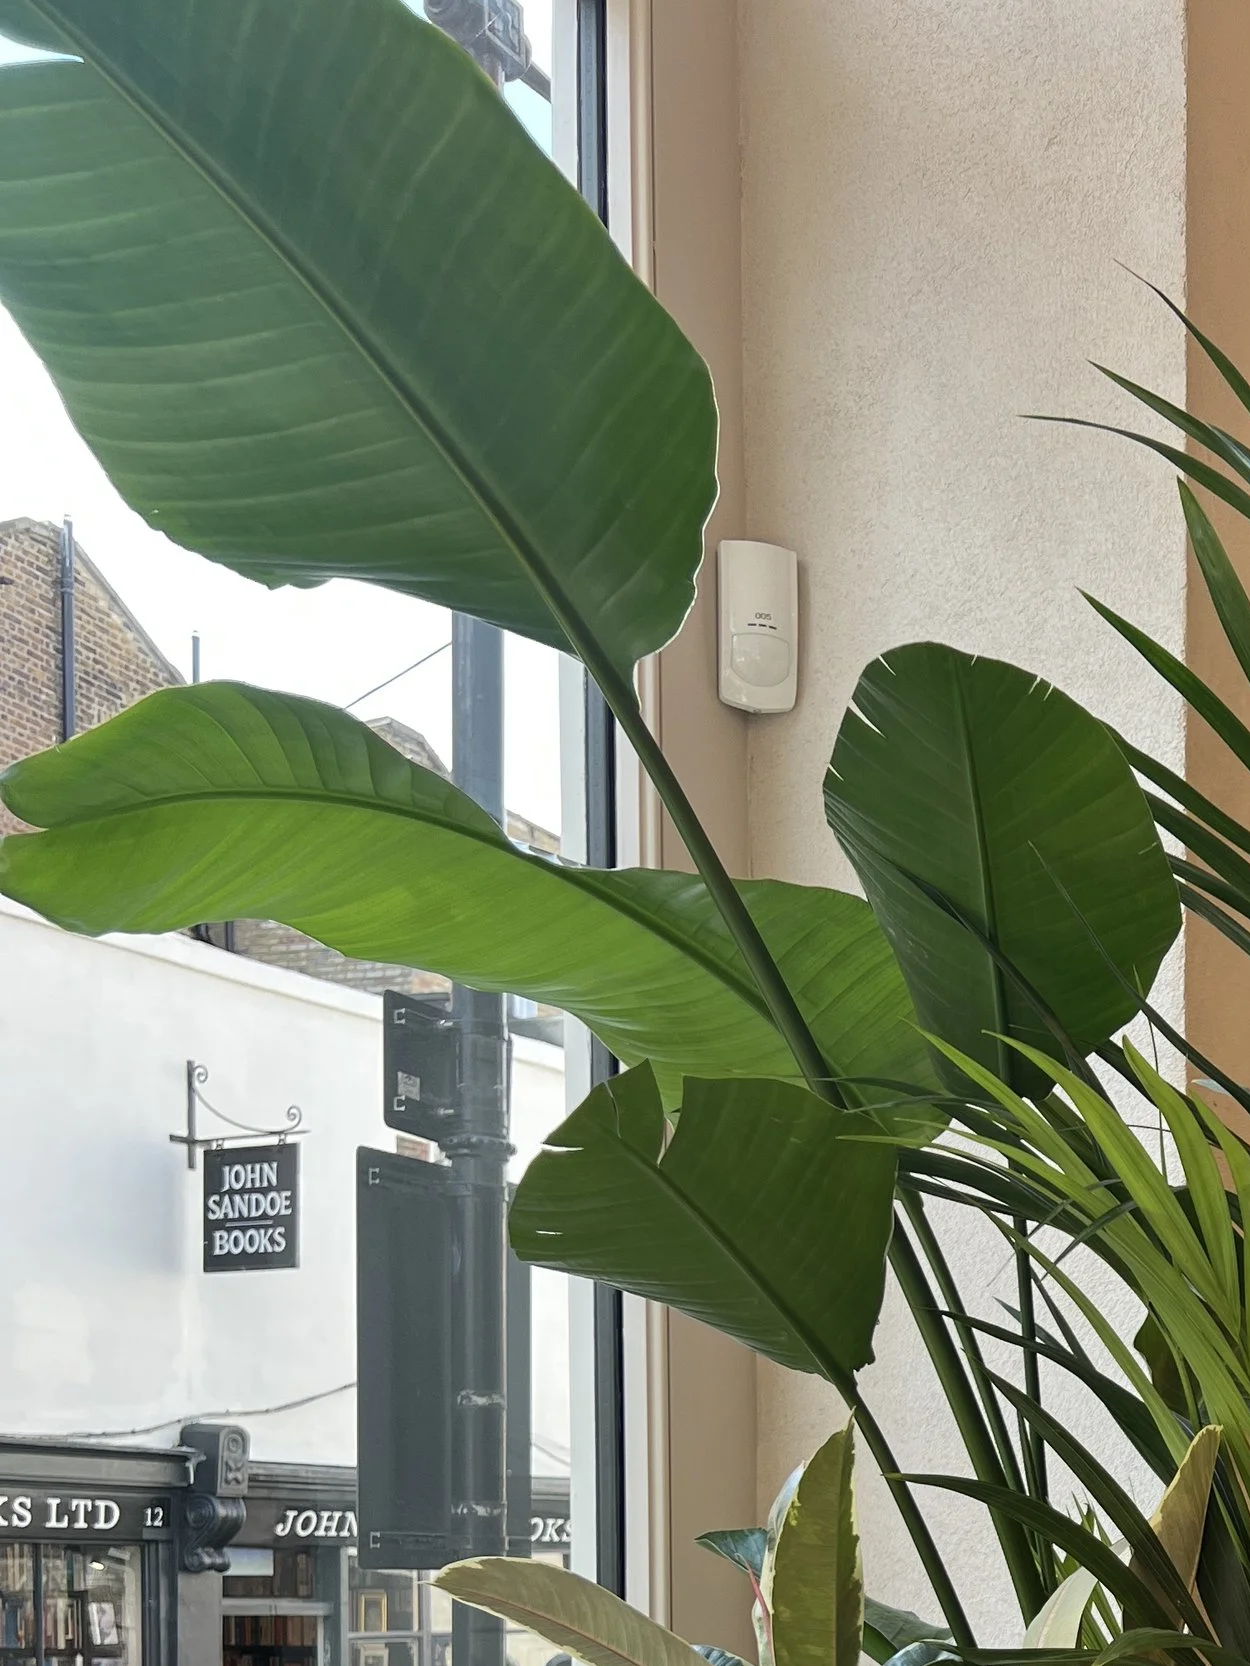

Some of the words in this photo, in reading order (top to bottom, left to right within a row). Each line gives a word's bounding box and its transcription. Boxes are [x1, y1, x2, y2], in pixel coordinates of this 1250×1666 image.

[220, 1161, 278, 1193] JOHN
[207, 1190, 292, 1221] SANDOE
[213, 1226, 287, 1256] BOOKS
[45, 1497, 120, 1530] LTD
[145, 1506, 164, 1528] 12
[275, 1509, 358, 1538] JOHN
